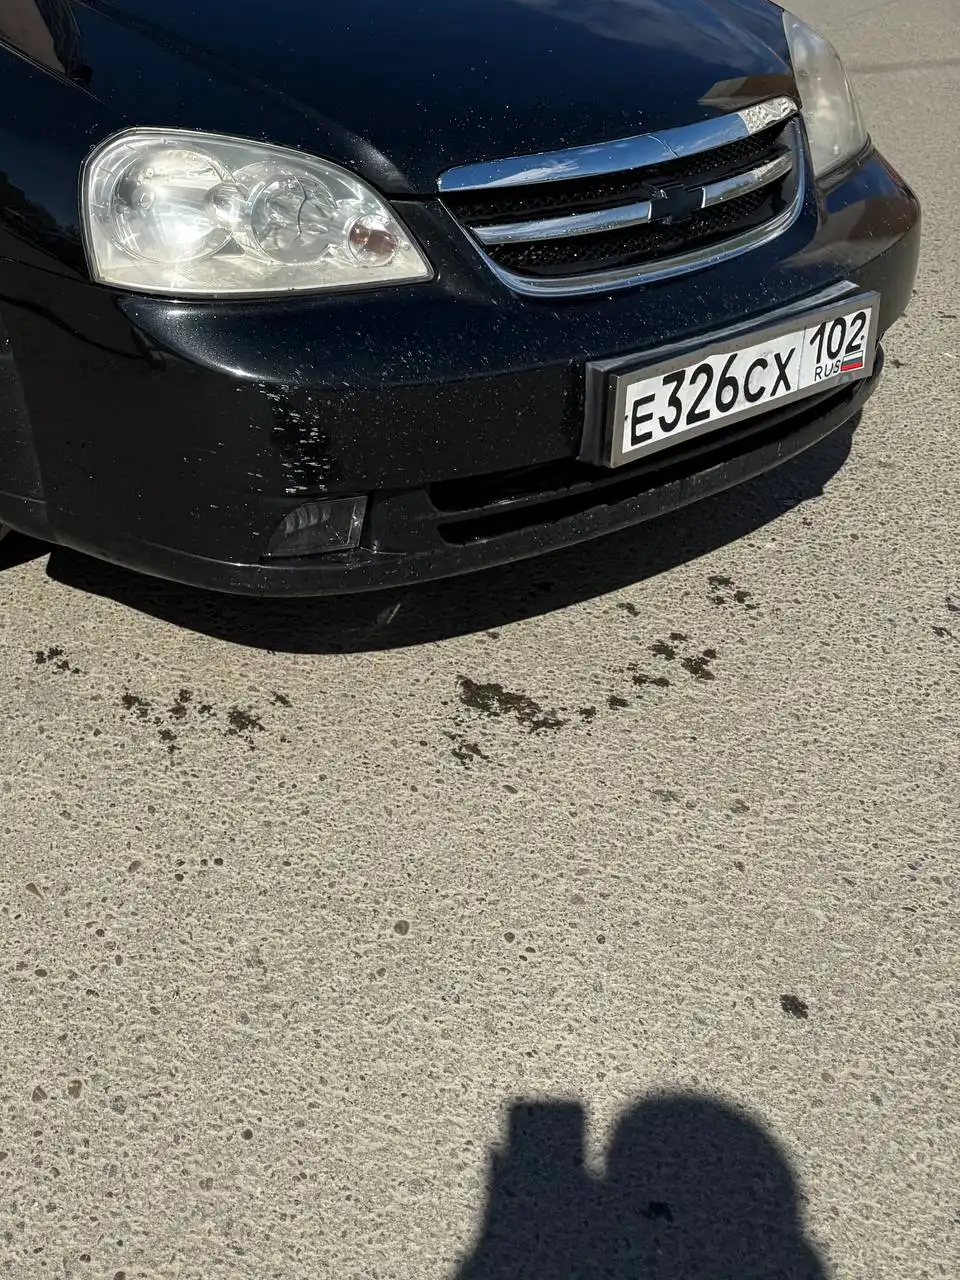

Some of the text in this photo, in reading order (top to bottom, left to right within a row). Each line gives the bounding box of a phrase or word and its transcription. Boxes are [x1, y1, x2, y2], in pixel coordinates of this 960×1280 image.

[630, 311, 867, 446] Е326СХ 102
[814, 359, 841, 382] RUS
